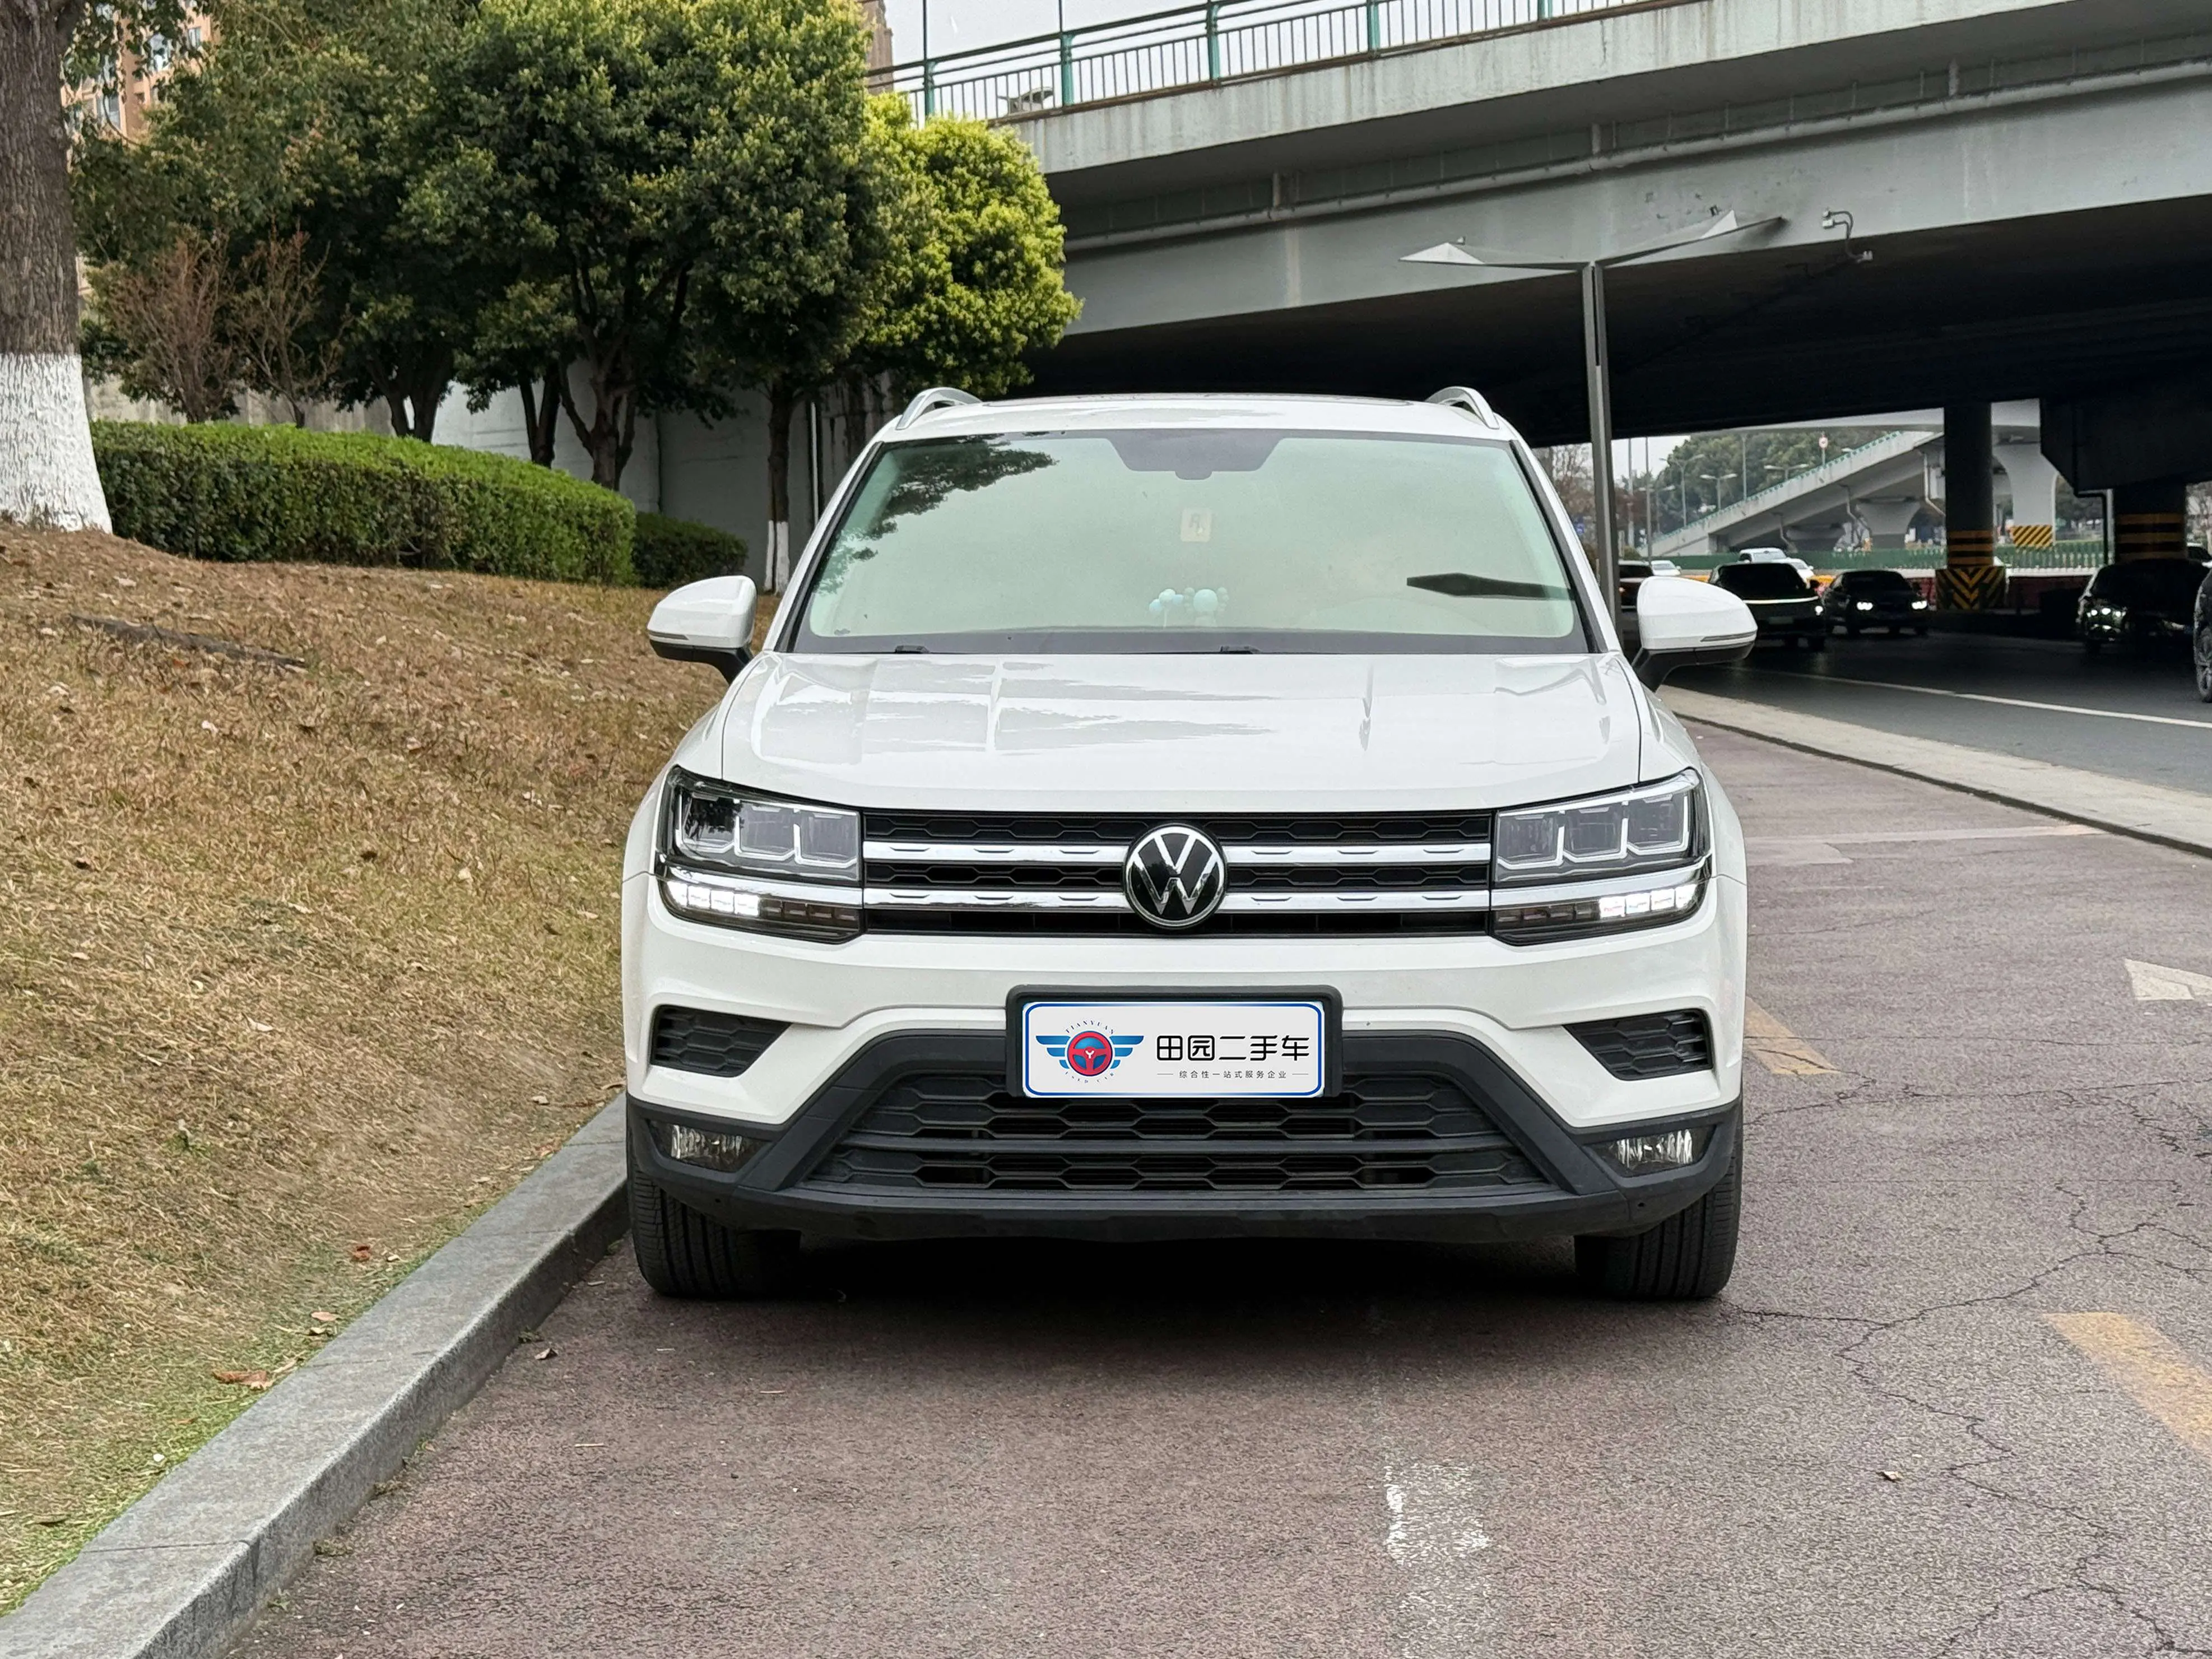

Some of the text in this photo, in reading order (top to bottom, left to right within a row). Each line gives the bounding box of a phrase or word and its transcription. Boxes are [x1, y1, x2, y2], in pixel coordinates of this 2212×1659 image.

[1131, 829, 1220, 917] VW
[1157, 1035, 1309, 1061] 田园二手车
[1179, 1070, 1286, 1079] 综合性一站式服务企业
